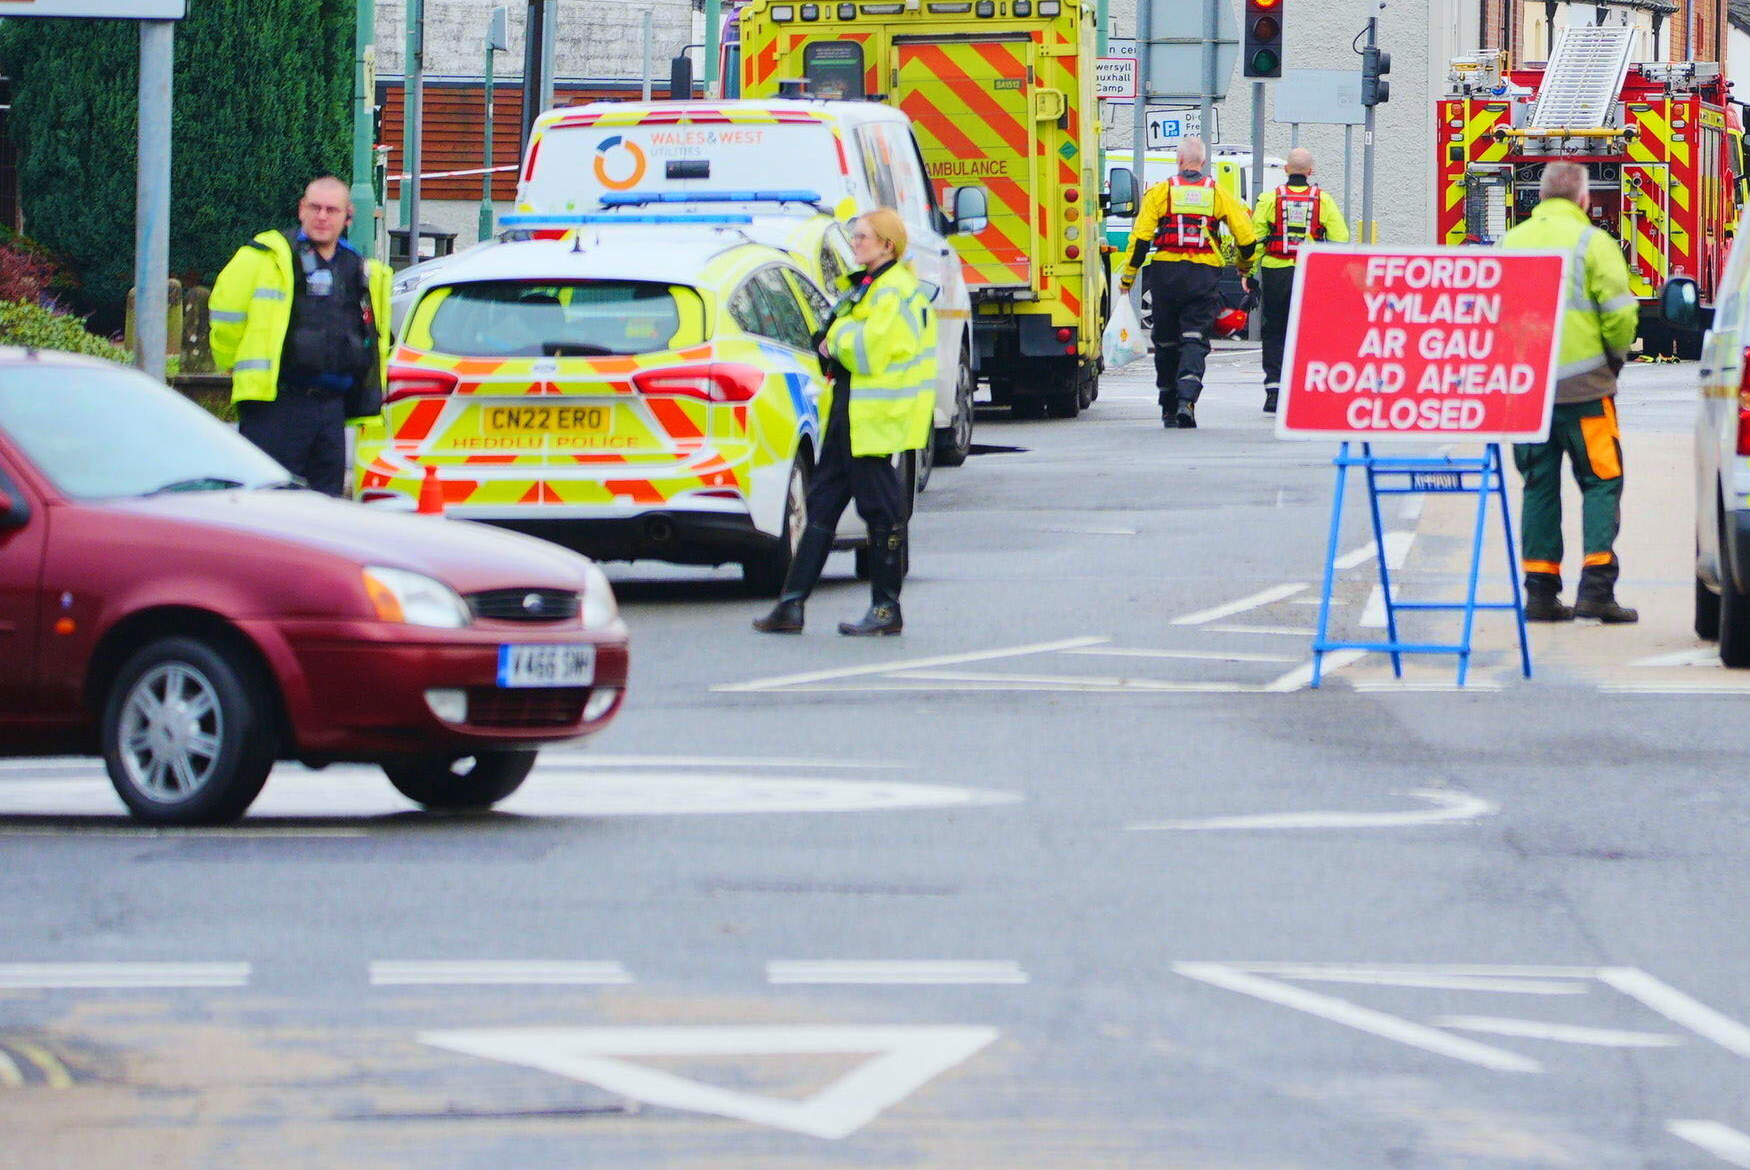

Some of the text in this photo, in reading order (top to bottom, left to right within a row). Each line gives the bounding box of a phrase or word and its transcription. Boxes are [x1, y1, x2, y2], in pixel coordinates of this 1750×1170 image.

[1096, 62, 1131, 74] wersyll
[925, 161, 1008, 177] AMBULANCE
[1366, 258, 1502, 288] FFORDD
[1363, 292, 1501, 324] YMLAEN
[1357, 327, 1494, 359] AR GAU
[1304, 361, 1535, 394] ROAD AHEAD
[492, 409, 602, 430] CN22 ERO
[1346, 397, 1486, 430] CLOSED
[453, 436, 640, 450] HEDDLU POLICE
